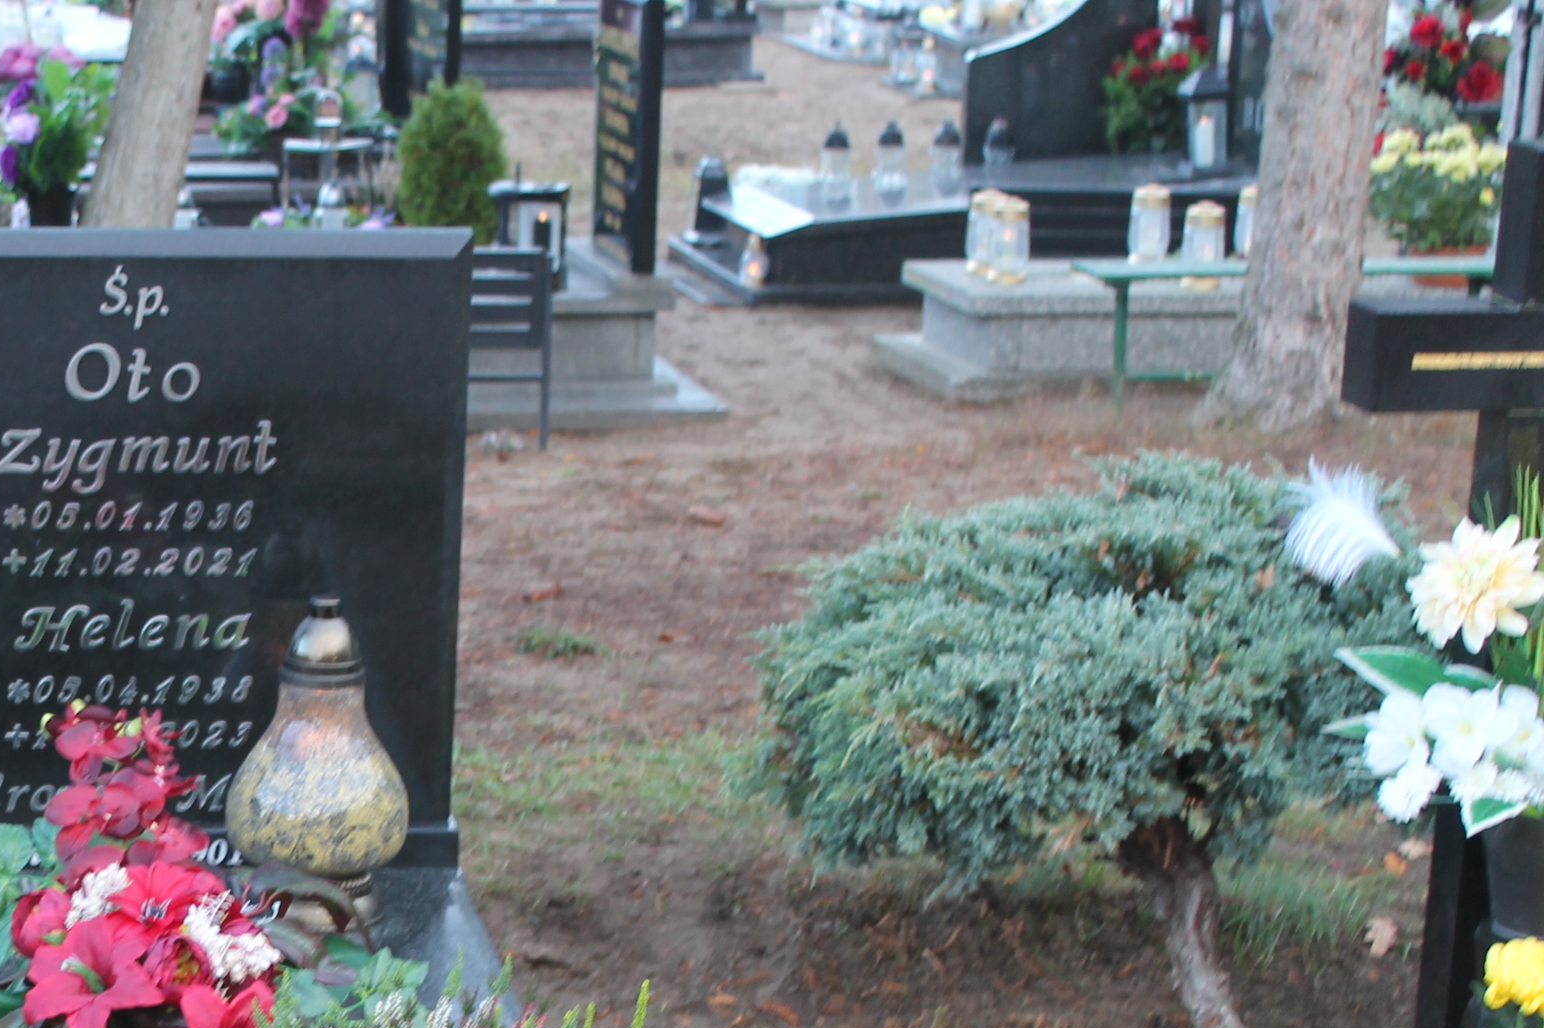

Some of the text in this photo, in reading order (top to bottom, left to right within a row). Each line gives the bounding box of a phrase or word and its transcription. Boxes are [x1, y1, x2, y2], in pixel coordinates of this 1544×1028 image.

[99, 264, 170, 330] Ś.p.
[64, 341, 201, 402] Oto
[13, 598, 252, 652] Helena
